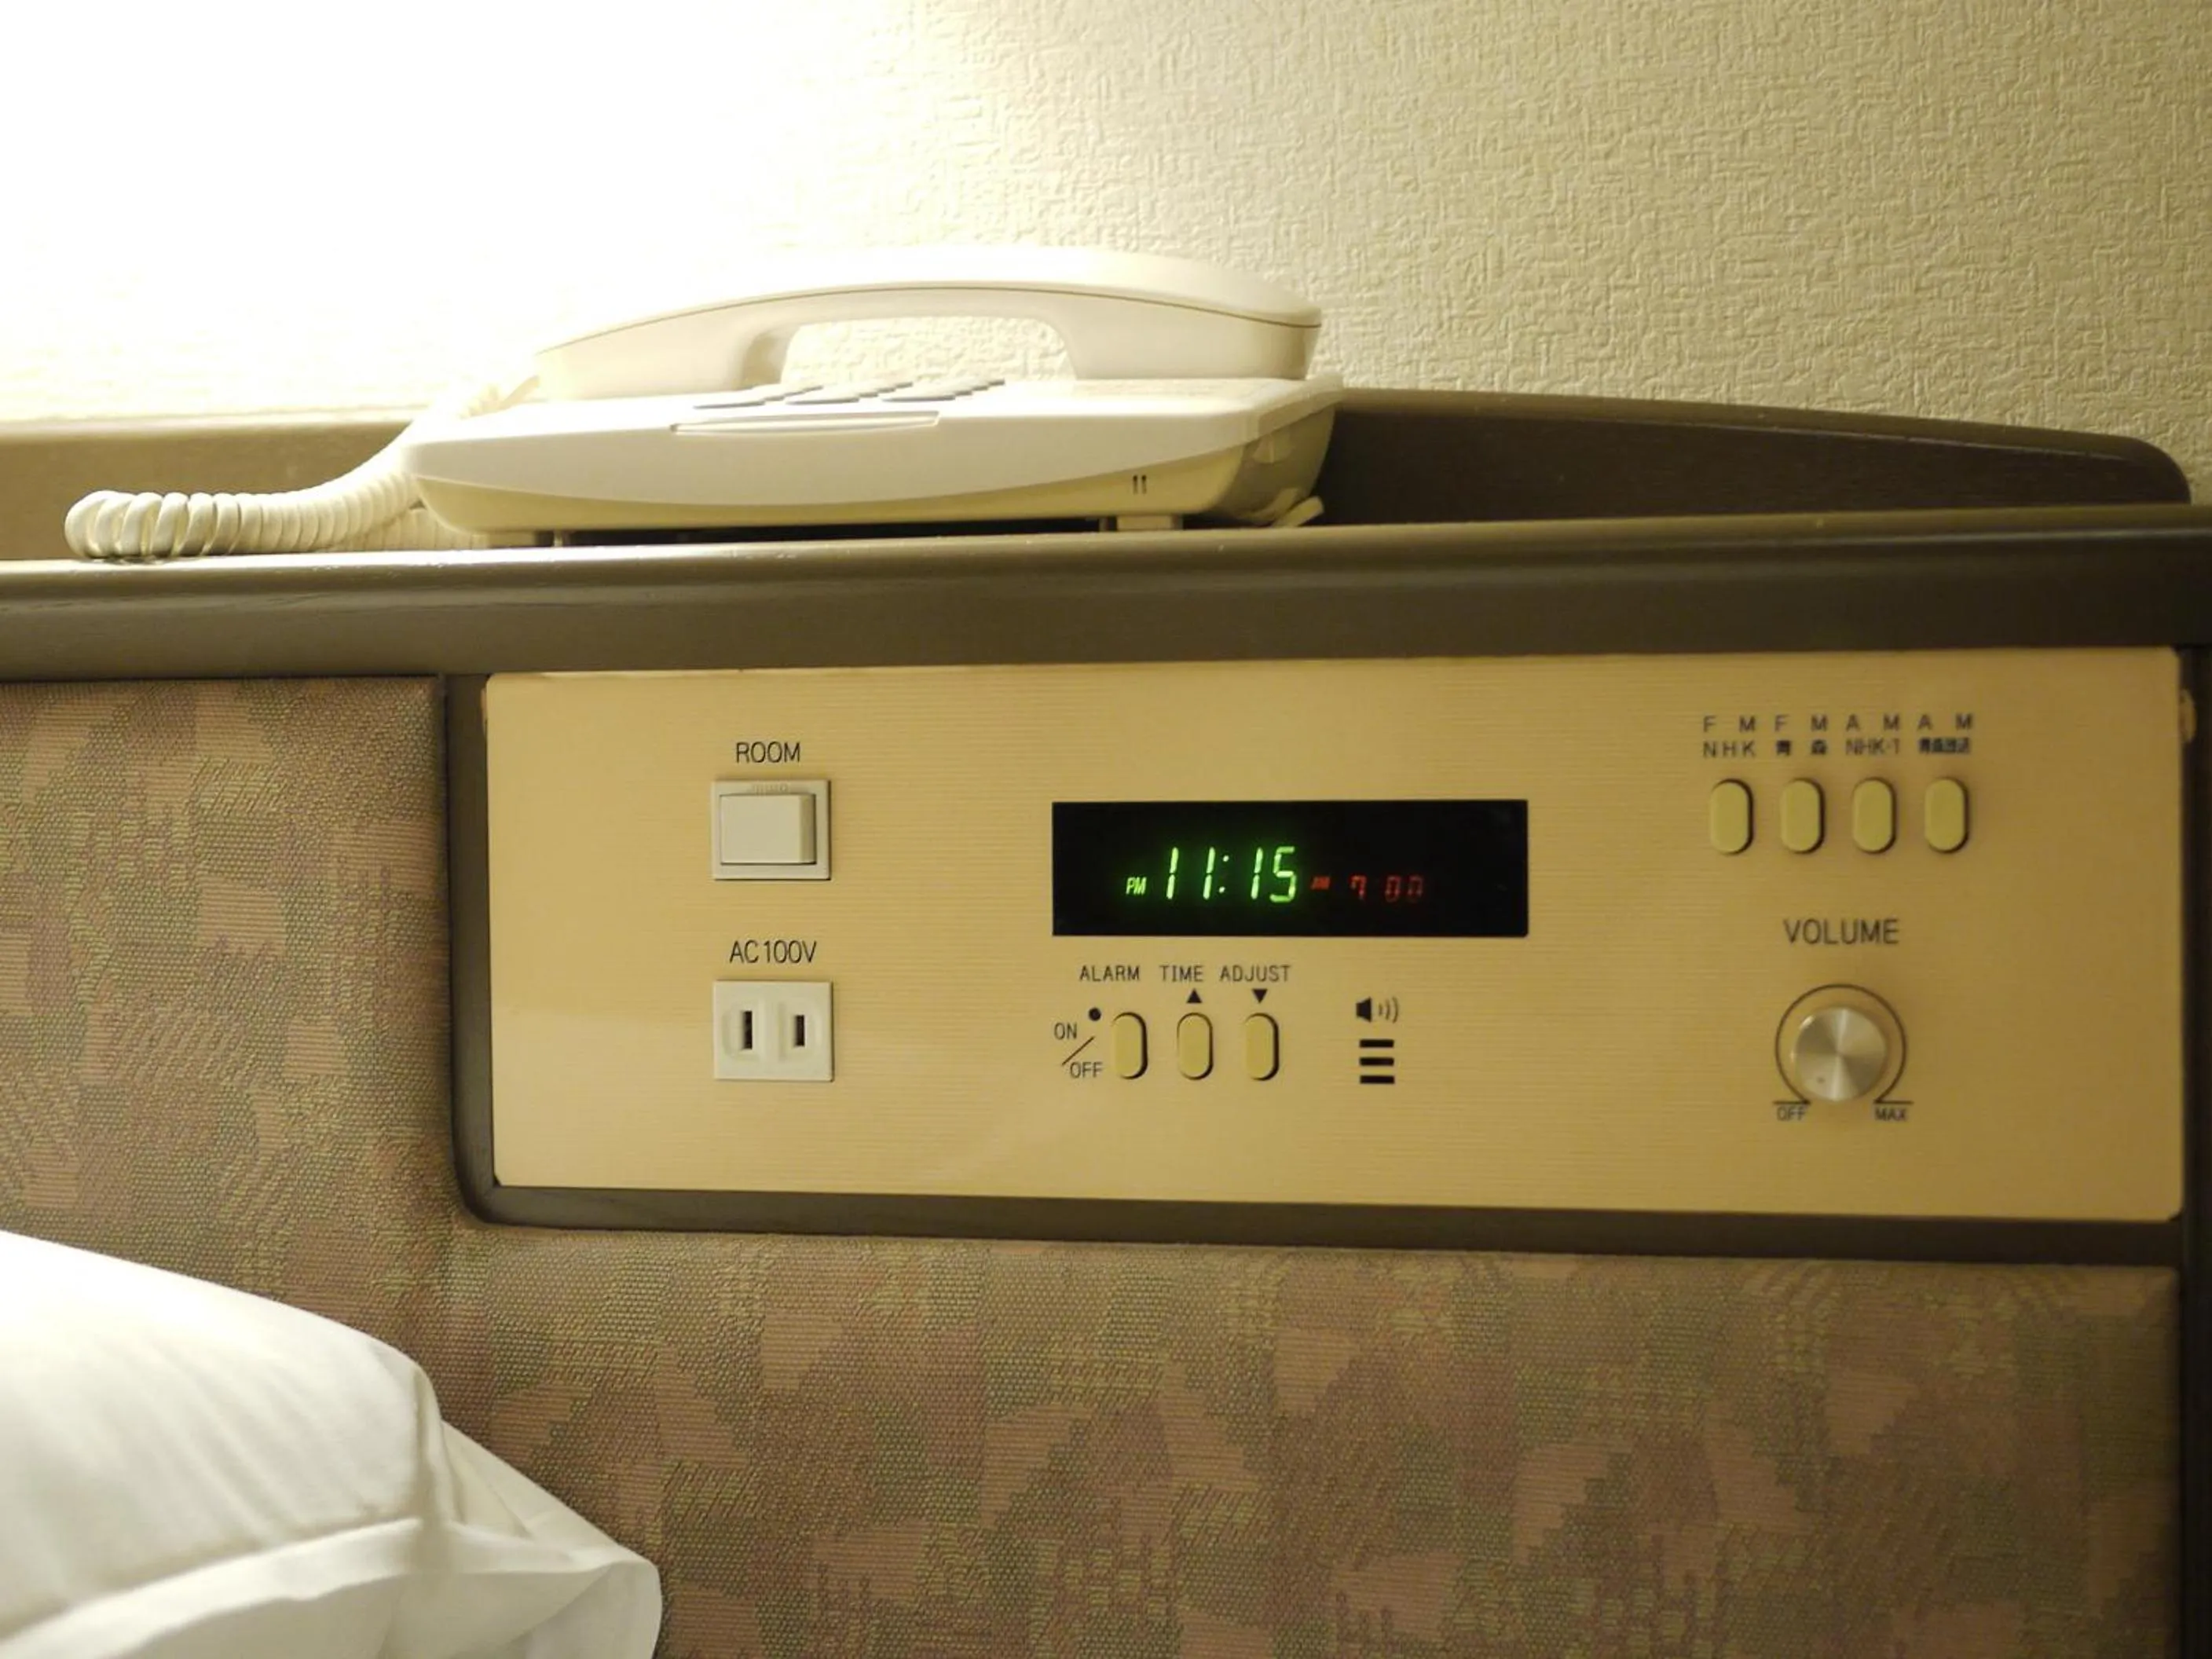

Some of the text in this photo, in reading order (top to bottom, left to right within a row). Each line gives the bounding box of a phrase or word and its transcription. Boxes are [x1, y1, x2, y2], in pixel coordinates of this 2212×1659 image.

[736, 742, 801, 763] ROOM
[1703, 741, 1756, 758] NHK
[1126, 846, 1298, 903] PM 11:15
[1783, 918, 1899, 945] VOLUME
[1079, 965, 1140, 982] ALARM
[1160, 965, 1291, 982] TIME ADJUST
[1054, 1023, 1078, 1040] ON
[1070, 1061, 1102, 1079] OFF
[1777, 1106, 1806, 1122] OFF
[1875, 1105, 1907, 1121] MAX
